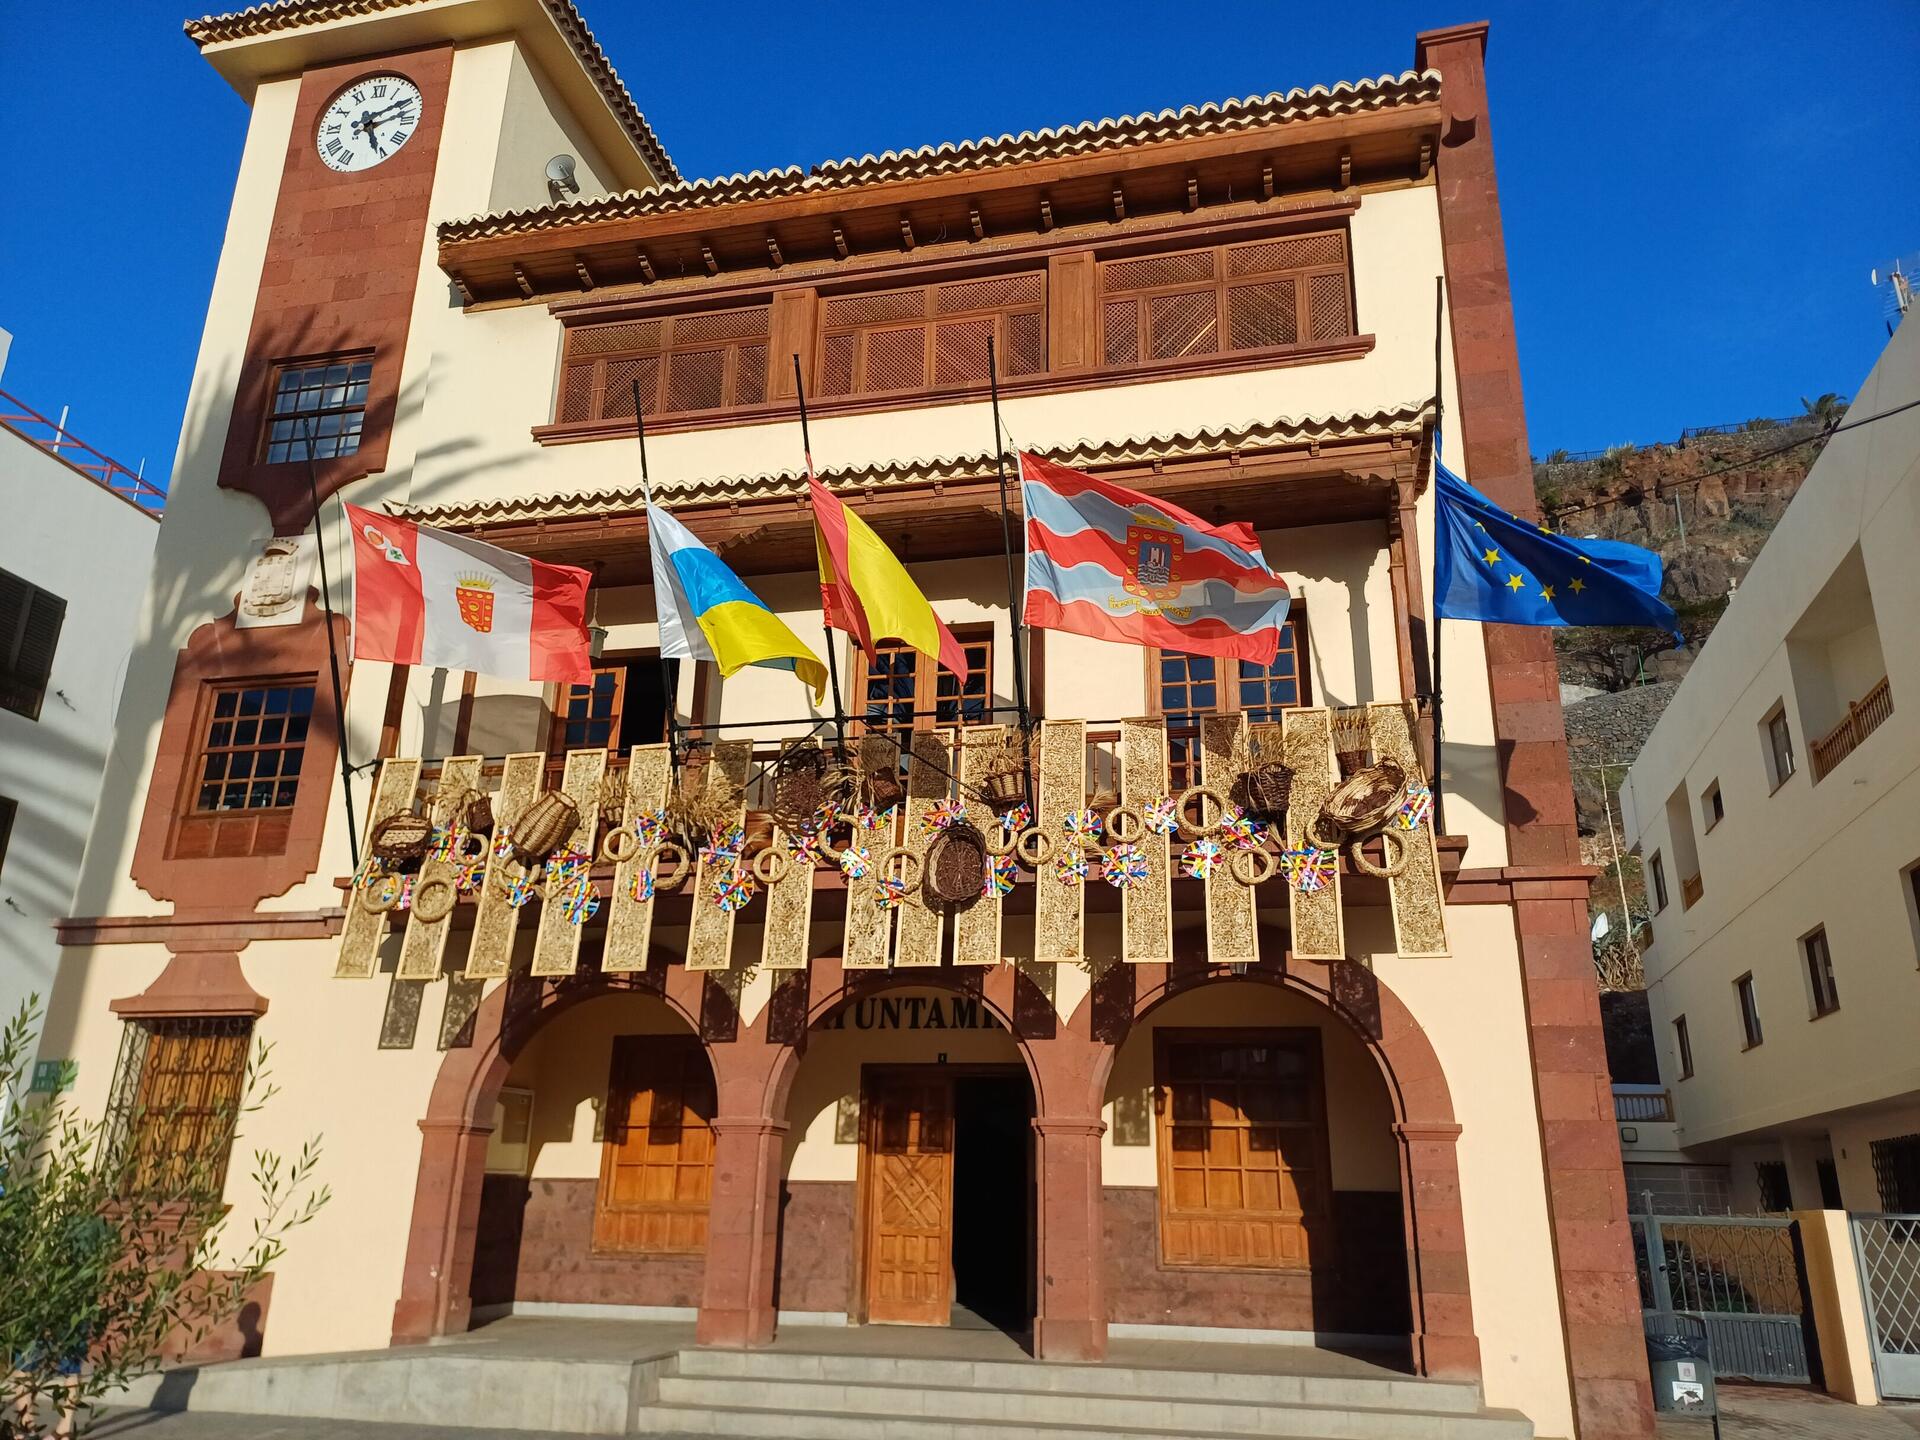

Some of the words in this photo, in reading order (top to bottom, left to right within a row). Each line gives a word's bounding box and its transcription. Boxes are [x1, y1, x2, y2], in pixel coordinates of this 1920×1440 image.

[351, 91, 366, 106] XI
[371, 85, 388, 98] XII
[336, 107, 351, 118] X
[337, 149, 354, 165] VII
[824, 997, 1003, 1030] YUNTAMI
